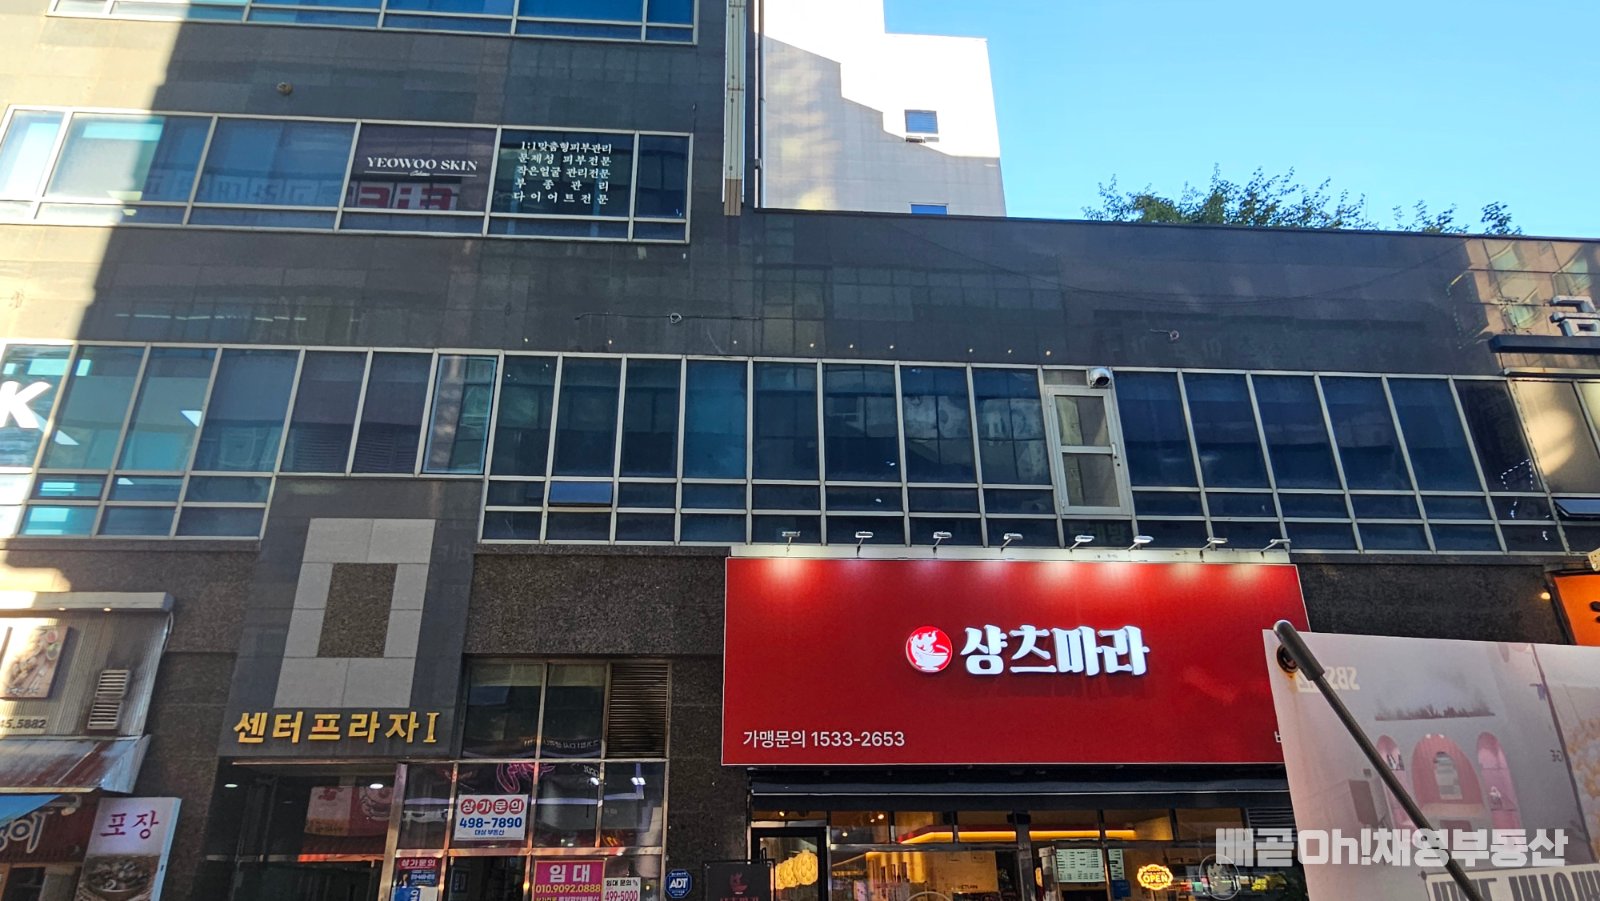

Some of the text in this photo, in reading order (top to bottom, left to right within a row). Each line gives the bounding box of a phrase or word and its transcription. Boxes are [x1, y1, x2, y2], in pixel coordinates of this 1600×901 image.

[367, 156, 478, 171] YEOWOO SKIN
[518, 153, 612, 167] 문제성 피부전문
[517, 165, 611, 179] 작은얼굴 관리전문
[960, 624, 1150, 677] 샹츠마라
[743, 730, 905, 748] 가맹문의 1533-2653
[461, 799, 523, 814] 상가문의
[100, 809, 160, 840] 포장
[459, 817, 522, 828] 498-7890
[549, 864, 590, 883] 임대
[1142, 874, 1169, 883] OPEN
[535, 884, 601, 893] 010.9092.0888
[669, 877, 688, 889] ADT
[605, 890, 638, 901] 499-5000
